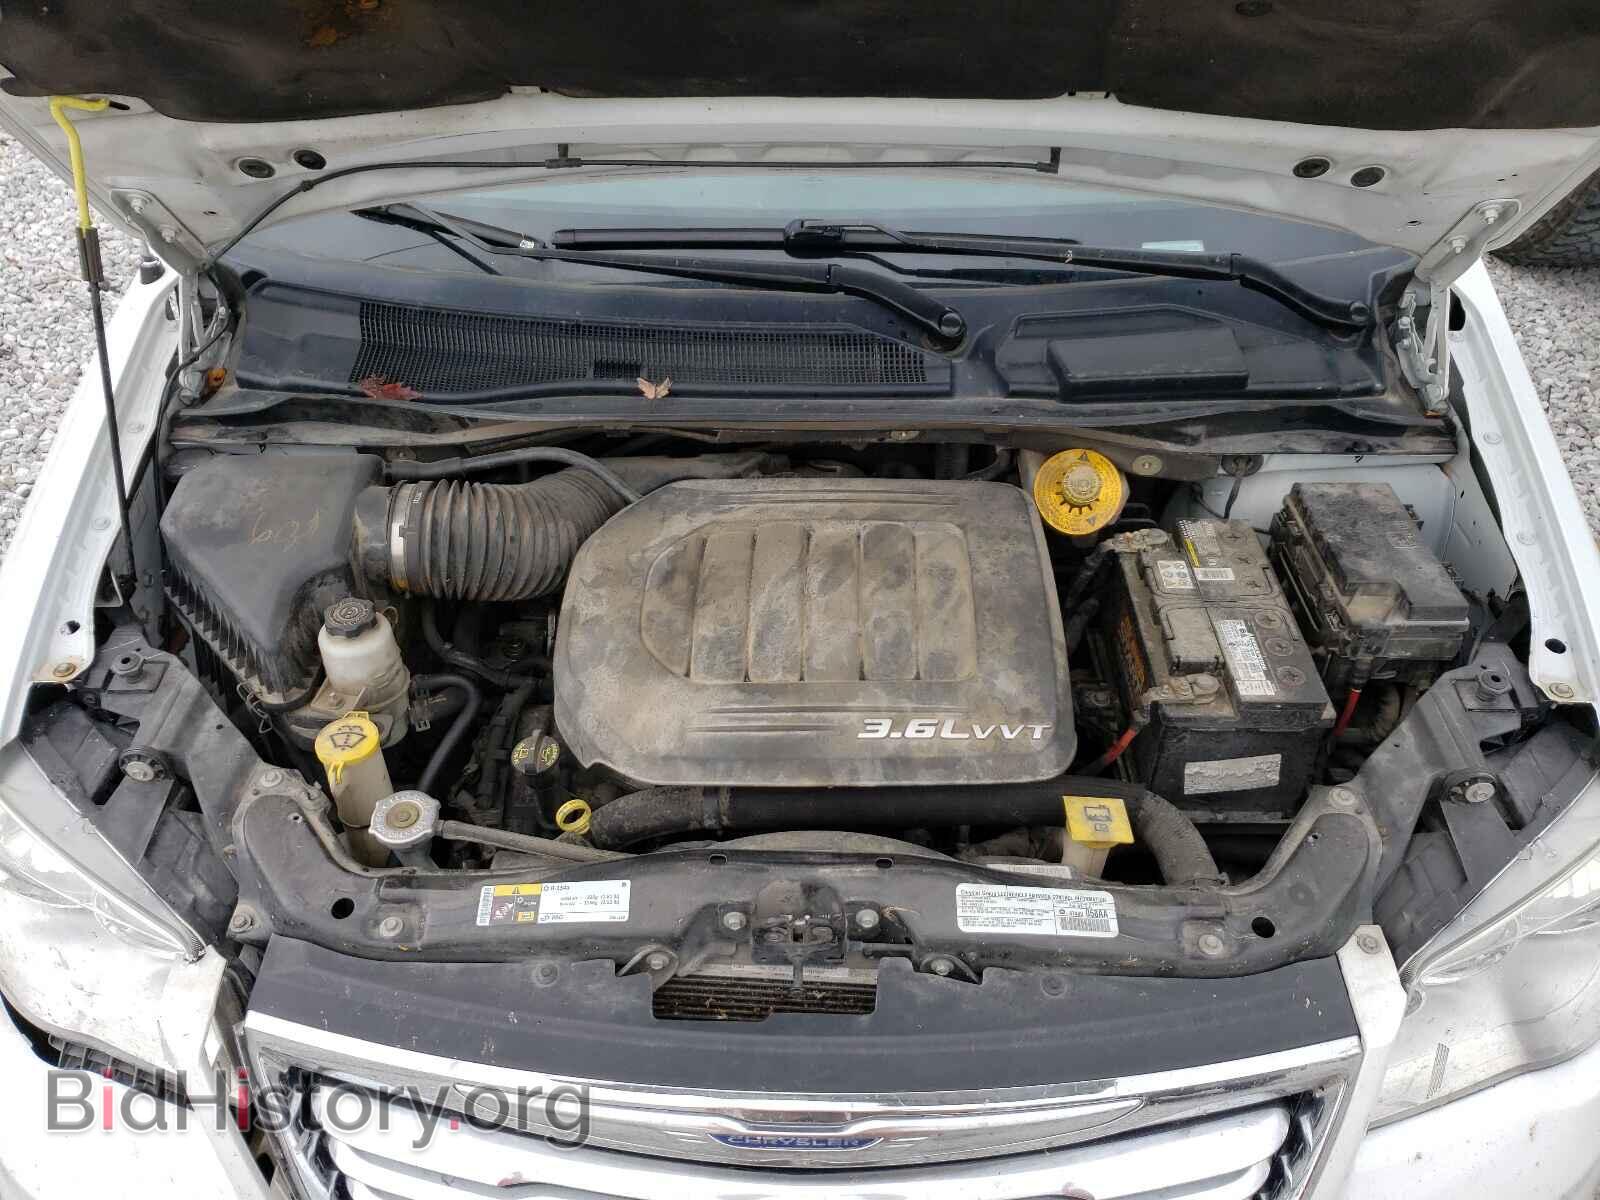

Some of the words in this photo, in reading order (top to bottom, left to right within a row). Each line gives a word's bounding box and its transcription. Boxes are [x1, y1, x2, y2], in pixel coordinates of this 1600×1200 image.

[857, 718, 970, 740] 3.6L
[972, 724, 1051, 740] VVT
[728, 1135, 858, 1147] CHRYSLER
